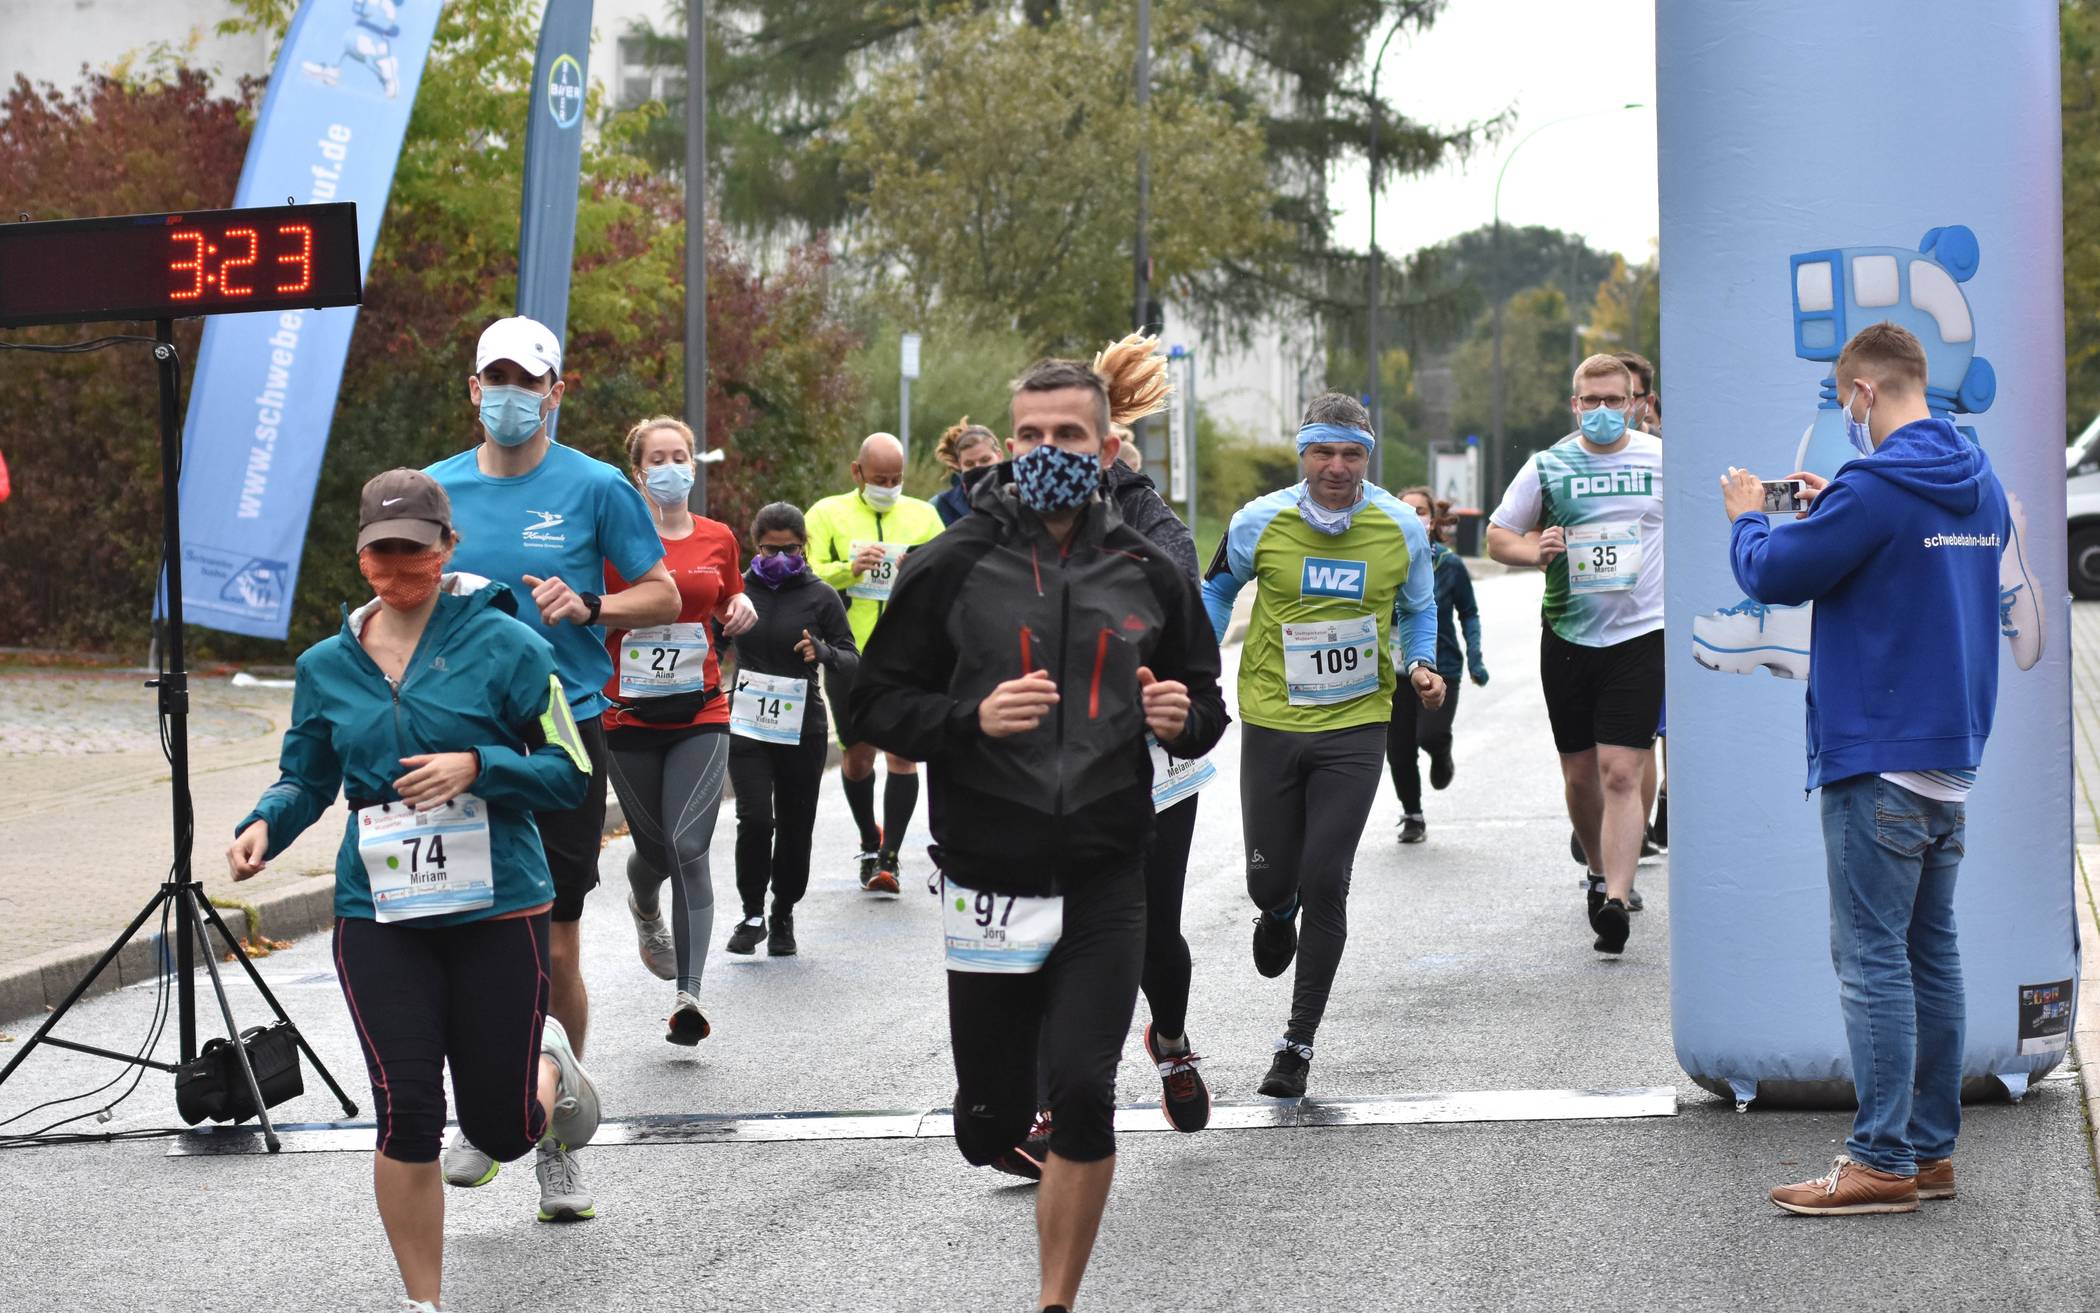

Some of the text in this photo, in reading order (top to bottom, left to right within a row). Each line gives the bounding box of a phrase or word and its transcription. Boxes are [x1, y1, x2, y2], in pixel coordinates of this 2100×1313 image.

[170, 224, 312, 299] 3:23
[237, 309, 304, 518] www.schwebe
[1592, 546, 1617, 566] 35
[1308, 566, 1360, 592] WZ
[1595, 565, 1617, 573] Marcel
[652, 648, 681, 671] 27
[1310, 647, 1358, 675] 109
[757, 697, 780, 718] 14
[1167, 759, 1196, 778] Melanie
[402, 834, 447, 872] 74
[410, 871, 447, 885] Miriam
[975, 891, 1016, 927] 97
[983, 927, 1005, 941] Jörg
